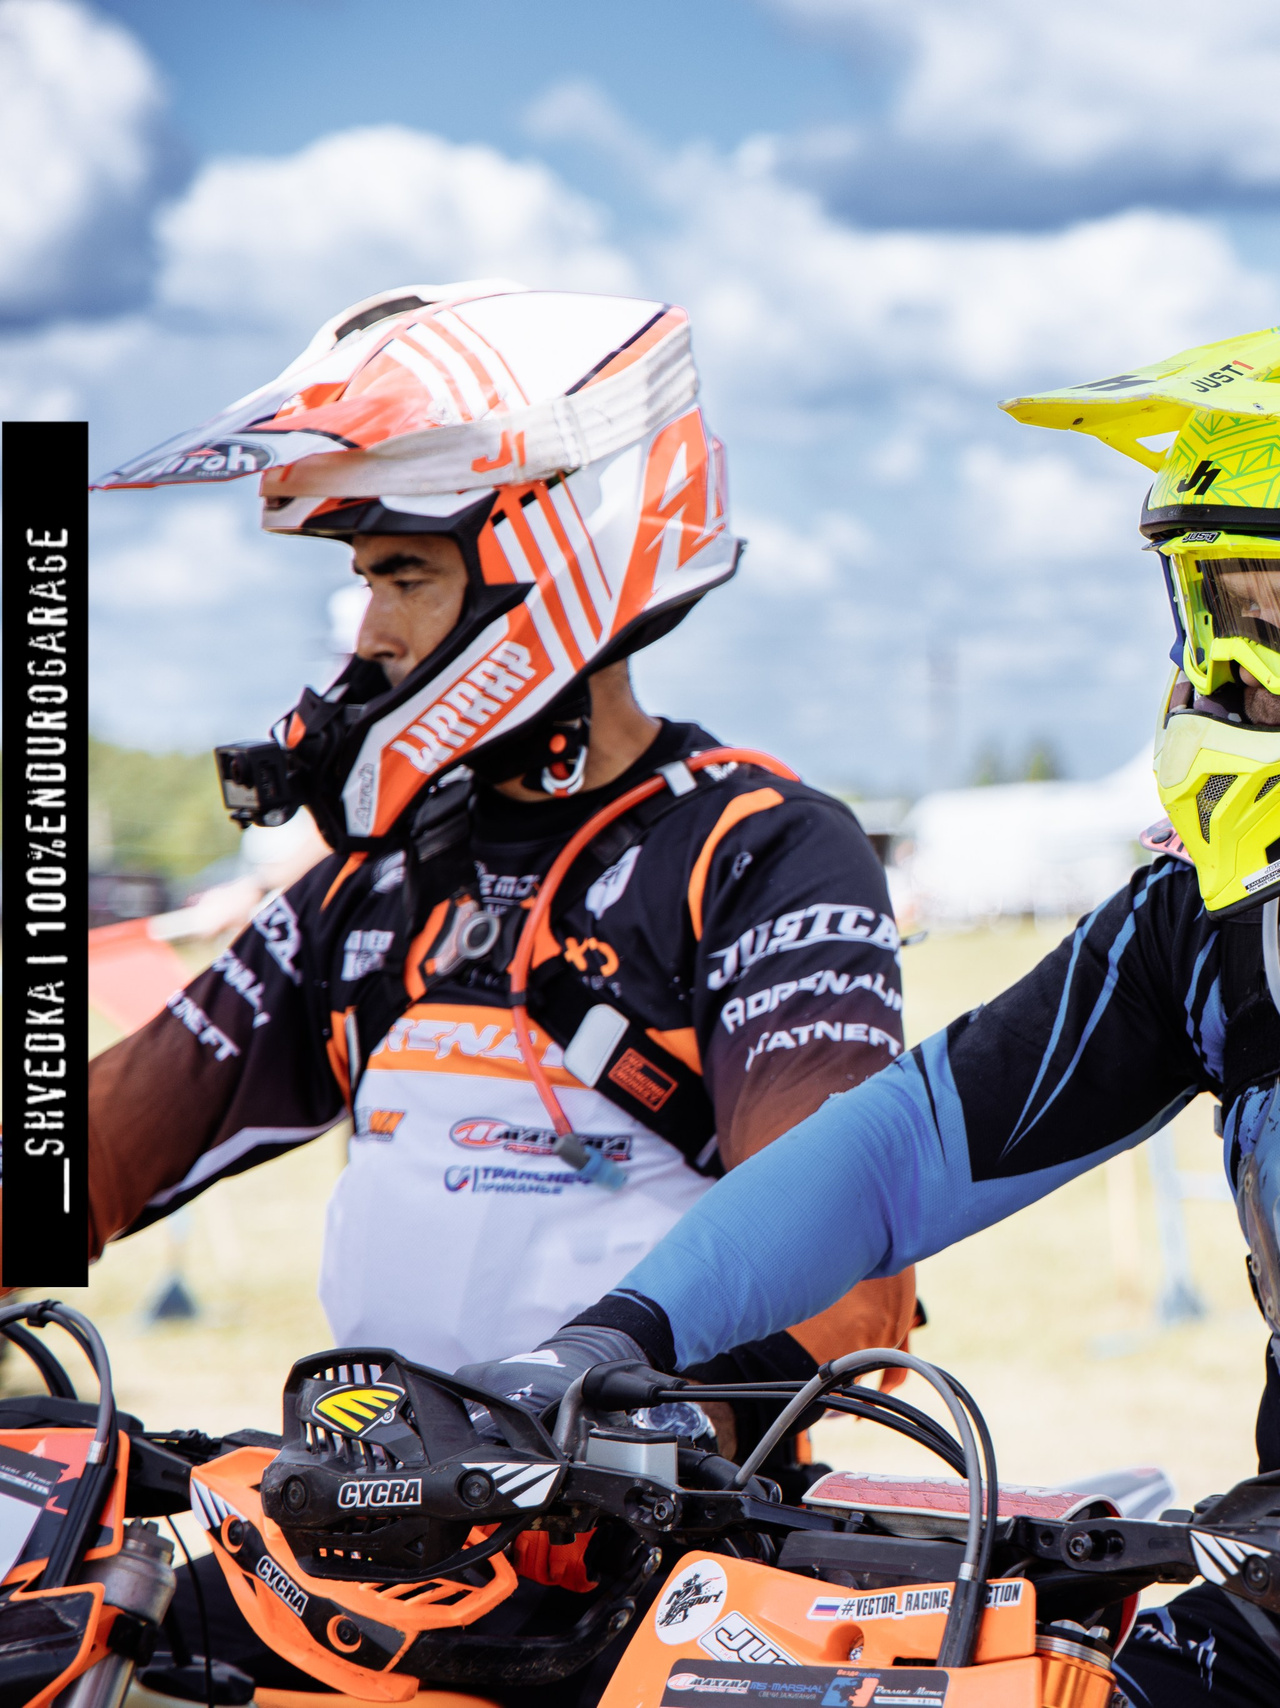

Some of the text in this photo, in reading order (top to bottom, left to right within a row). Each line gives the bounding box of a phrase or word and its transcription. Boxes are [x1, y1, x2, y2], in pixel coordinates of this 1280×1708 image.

[1190, 360, 1255, 393] JUST1
[339, 1479, 422, 1509] CYCRA
[256, 1555, 309, 1617] CYCRA
